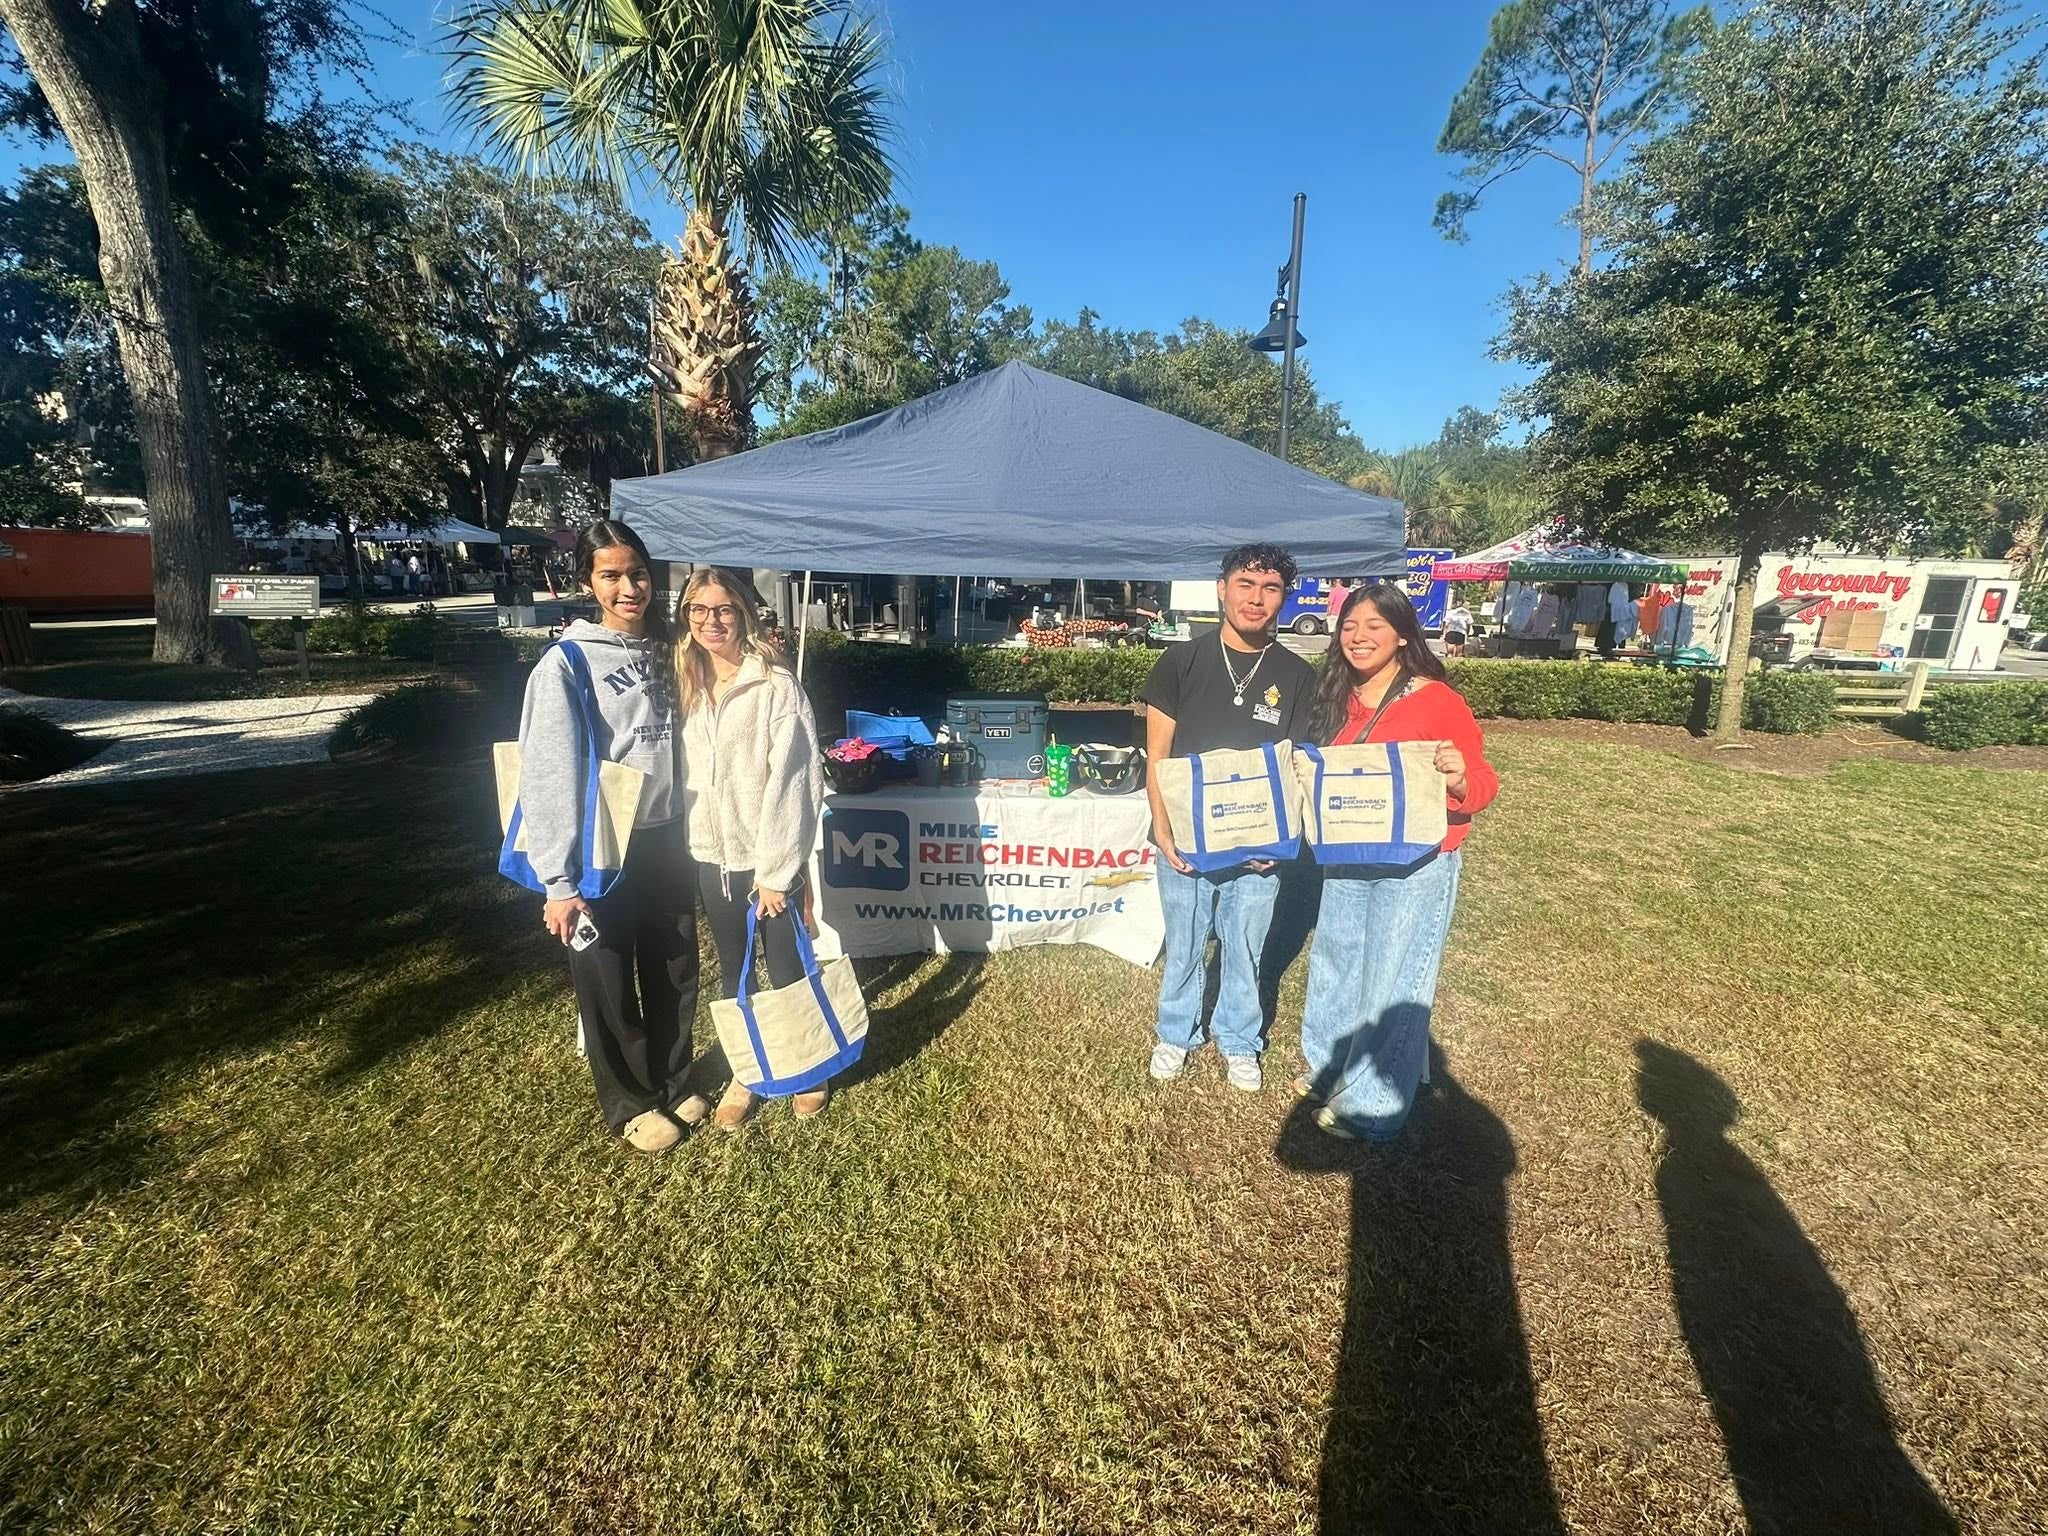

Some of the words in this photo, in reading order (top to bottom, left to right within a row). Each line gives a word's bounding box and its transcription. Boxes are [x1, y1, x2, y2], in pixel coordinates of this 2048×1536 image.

[1521, 562, 1563, 577] Jersey
[1567, 563, 1603, 574] Girl's
[1608, 564, 1651, 577] Italian
[1777, 565, 1912, 601] Lowcountry
[986, 729, 1009, 737] YETI
[919, 823, 998, 839] MIKE
[832, 831, 904, 870] MR
[919, 842, 1157, 868] REICHENBACH
